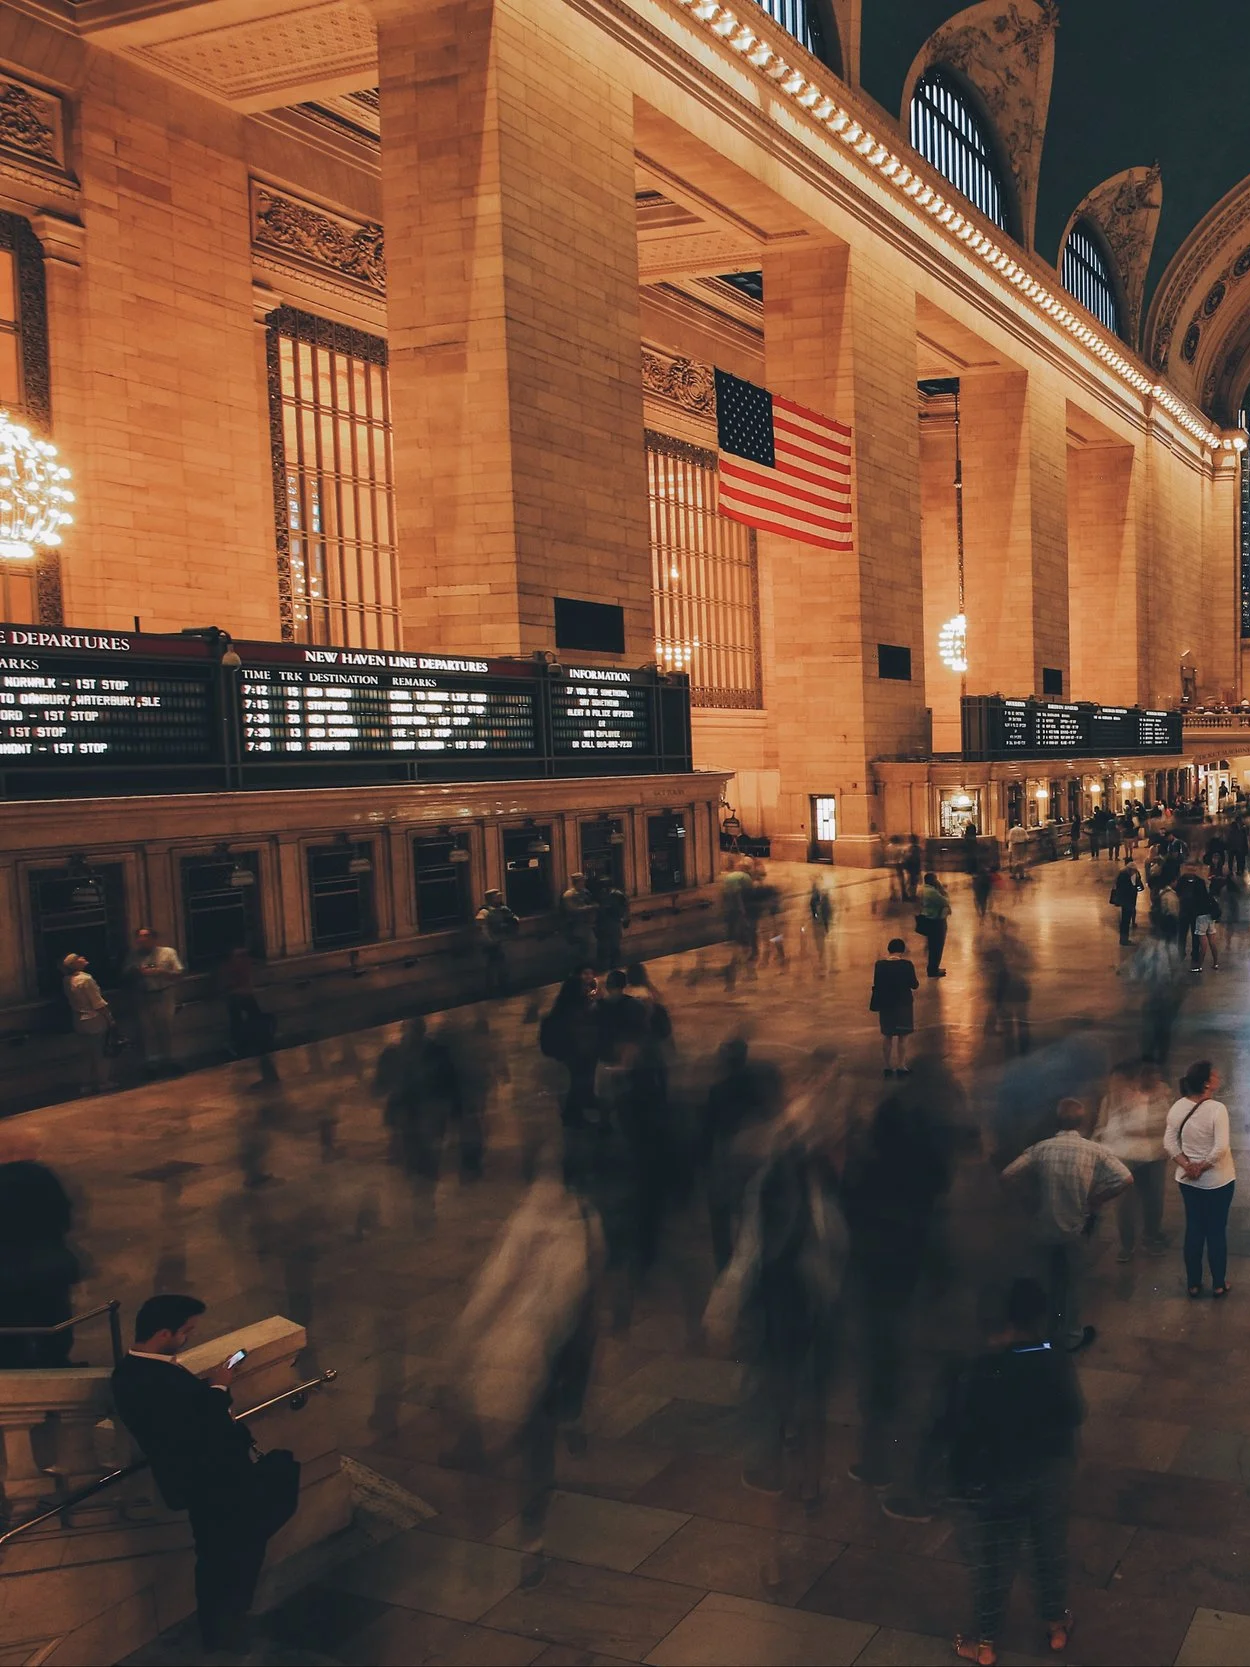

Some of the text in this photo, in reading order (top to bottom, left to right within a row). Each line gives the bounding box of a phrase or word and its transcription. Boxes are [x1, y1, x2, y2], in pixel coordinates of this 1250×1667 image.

[12, 631, 130, 651] DEPARTURES
[0, 658, 39, 670] ARKS
[305, 651, 488, 672] NEW HAVEN LINE DEPARTURES
[242, 670, 437, 688] TIME TRK DESTINATION REMARKS
[569, 668, 630, 682] INFORMATION
[4, 676, 56, 688] NORWALK
[76, 679, 96, 690] 1ST
[102, 680, 130, 690] STOP
[243, 684, 268, 696] 7:12
[244, 699, 270, 710] 7:15
[0, 710, 22, 721] ORD
[44, 711, 65, 721] 1ST
[70, 711, 98, 722] STOP
[10, 727, 66, 738] 1ST STOP
[54, 744, 74, 754] 1ST
[80, 743, 108, 754] STOP
